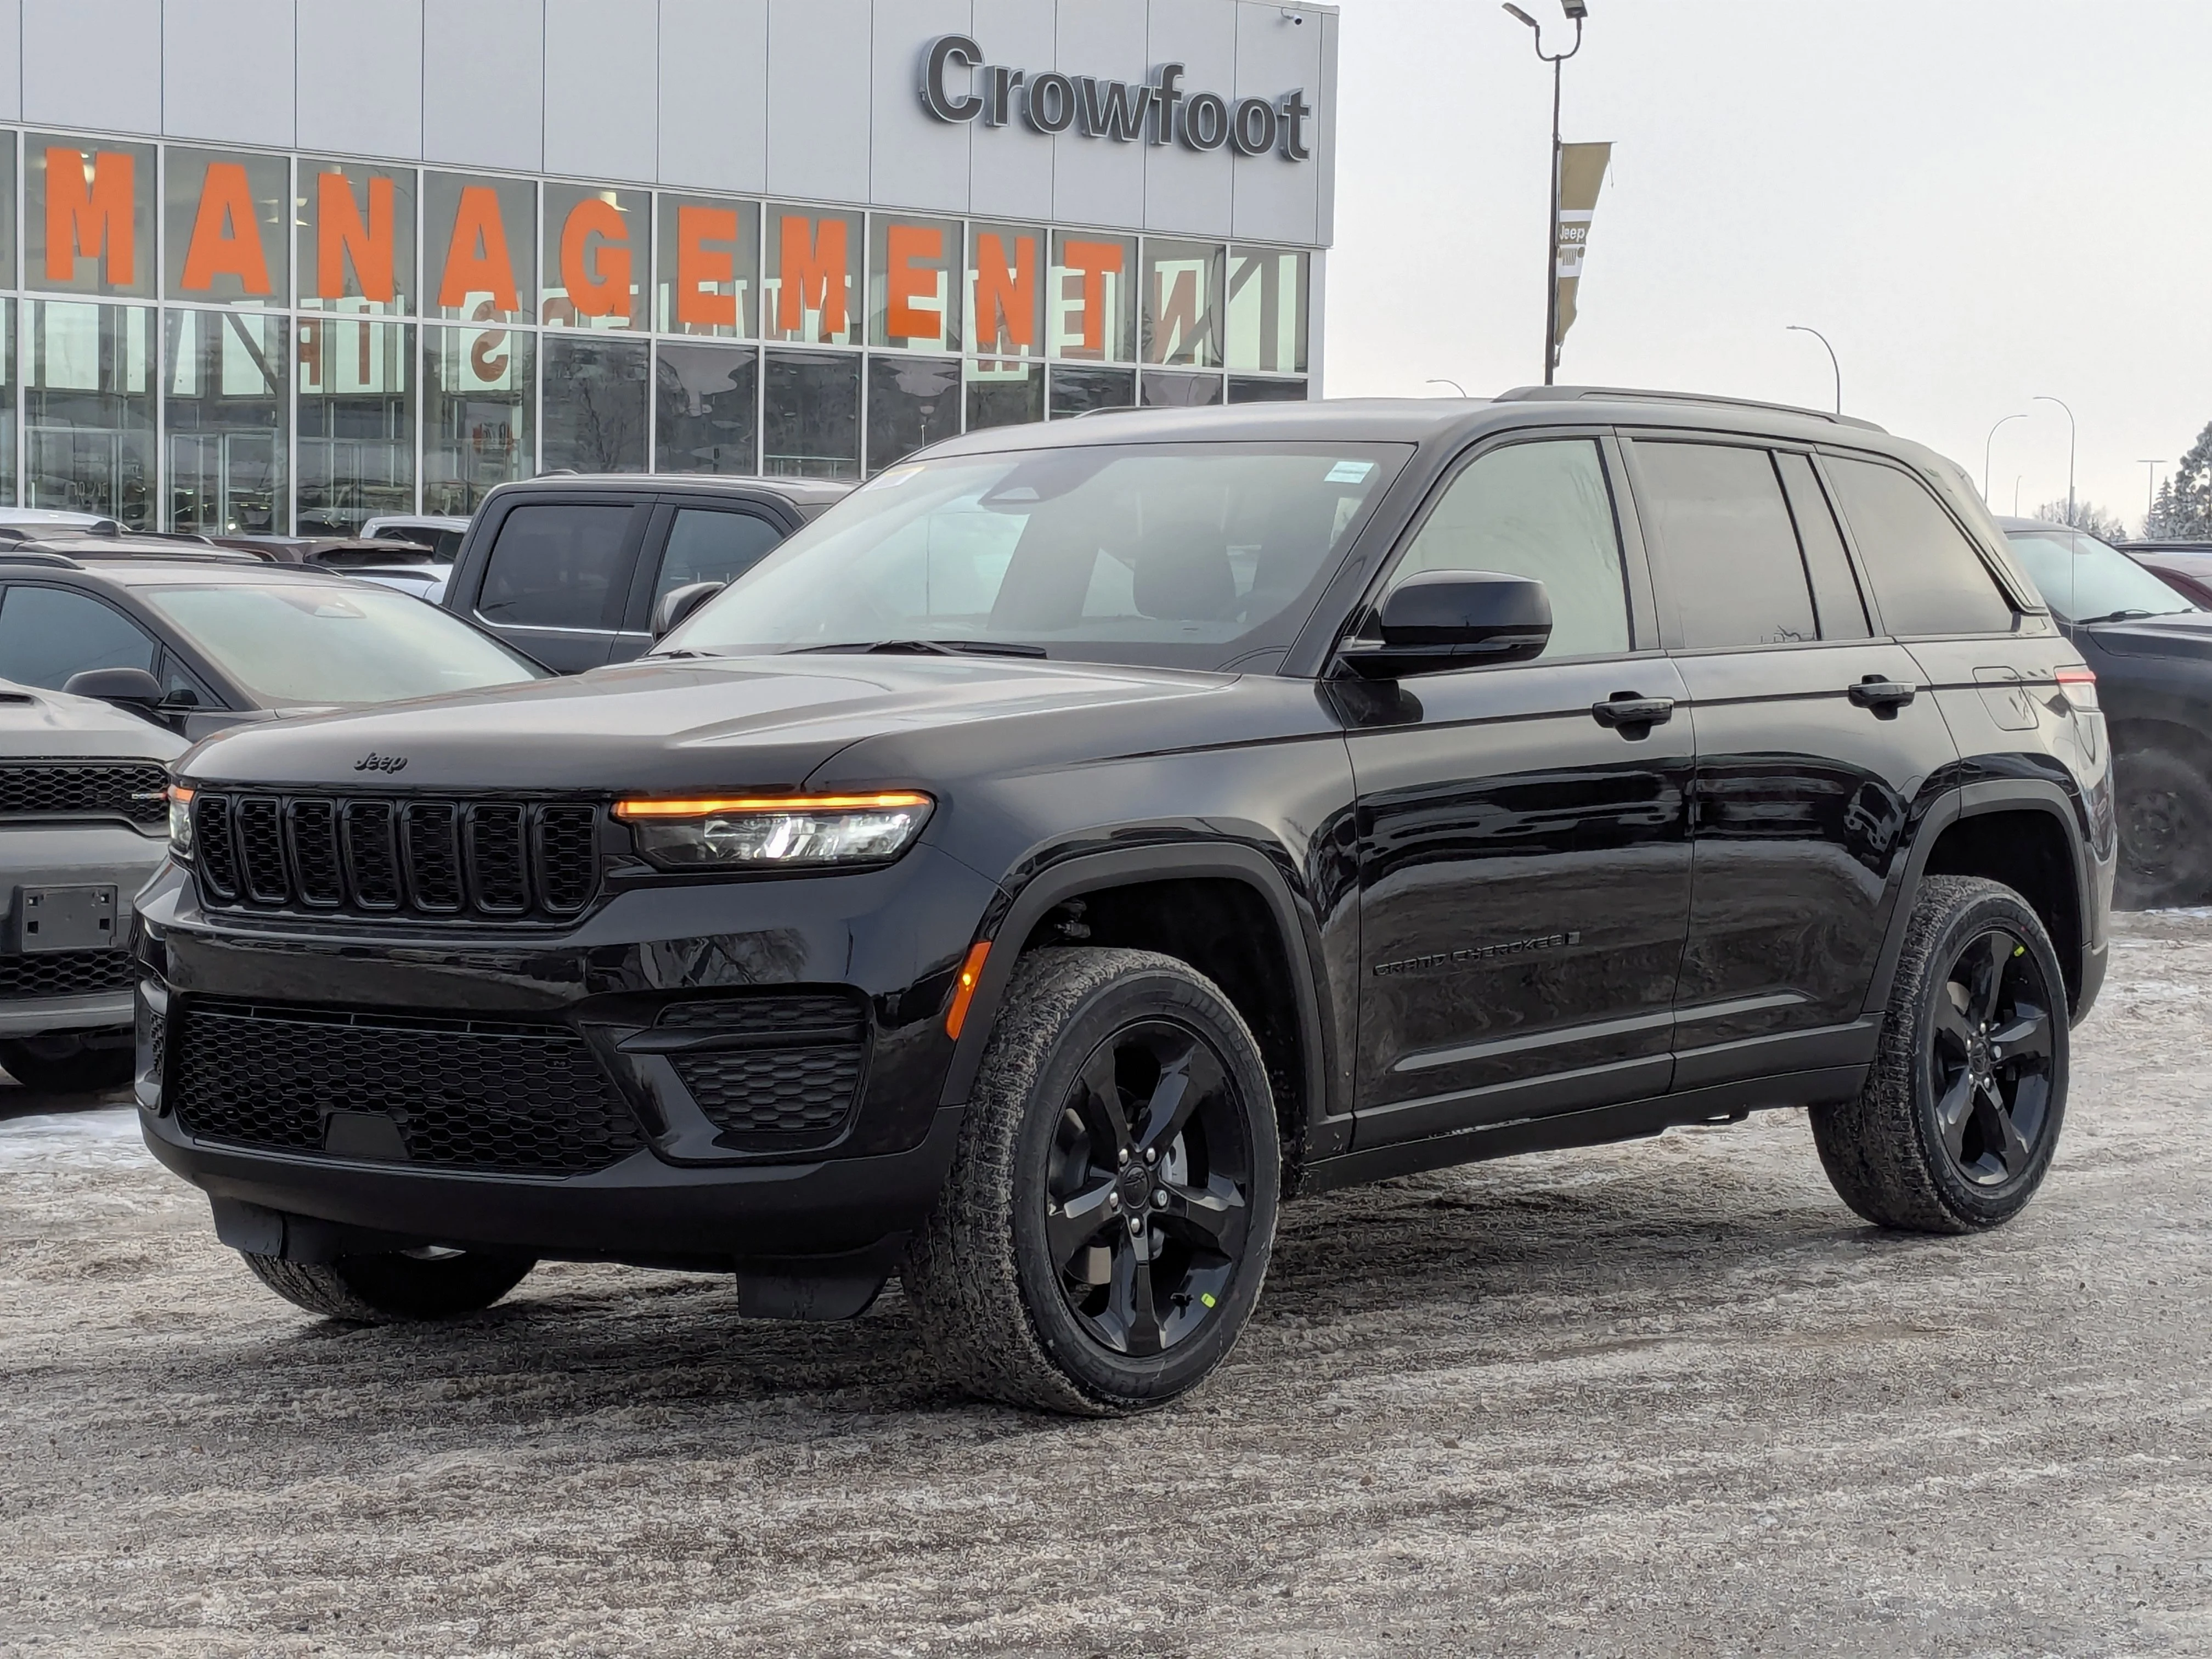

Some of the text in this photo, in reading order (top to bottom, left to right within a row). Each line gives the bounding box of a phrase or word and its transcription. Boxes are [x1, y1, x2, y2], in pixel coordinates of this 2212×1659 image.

[919, 33, 1311, 161] Crowfoot
[46, 148, 1123, 351] MANAGEMENT
[1559, 224, 1585, 242] Jeep
[354, 752, 408, 774] Jeep
